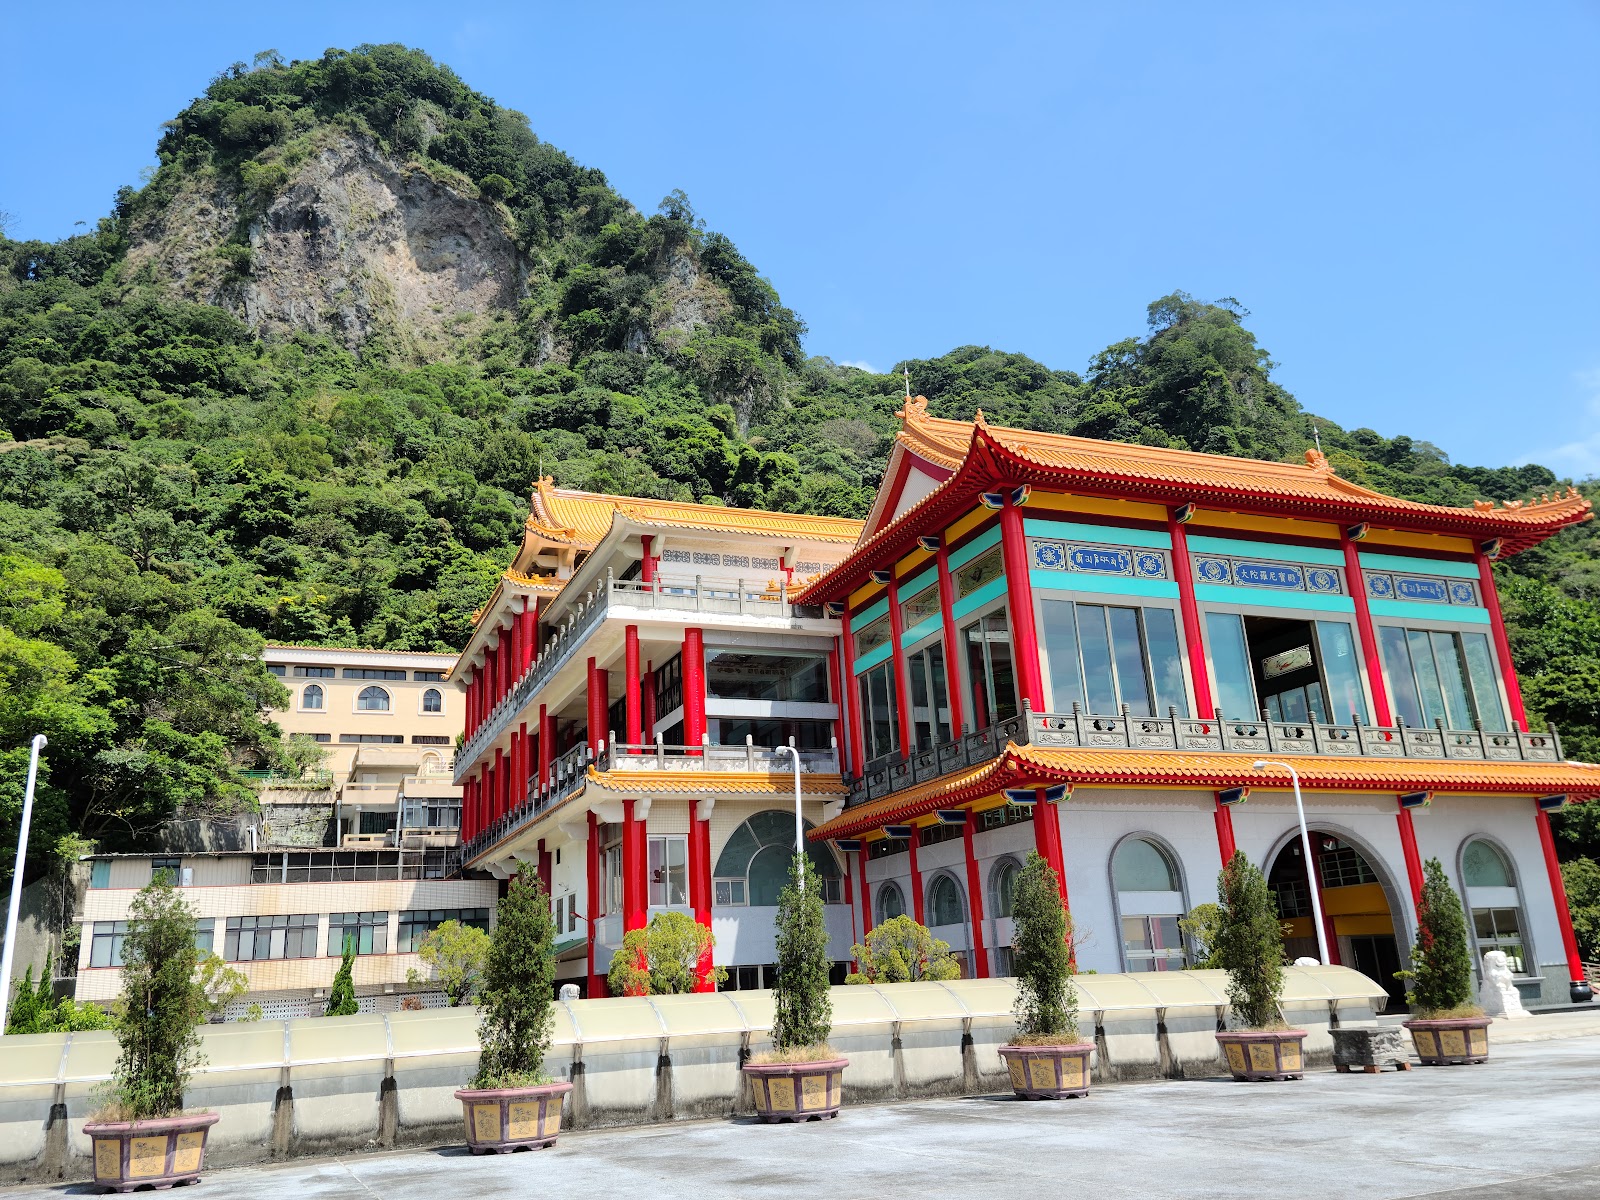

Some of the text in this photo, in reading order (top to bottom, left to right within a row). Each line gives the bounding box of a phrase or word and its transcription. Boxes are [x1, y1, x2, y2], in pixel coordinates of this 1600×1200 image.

[1241, 569, 1296, 583] 大陀羅尼寶殿
